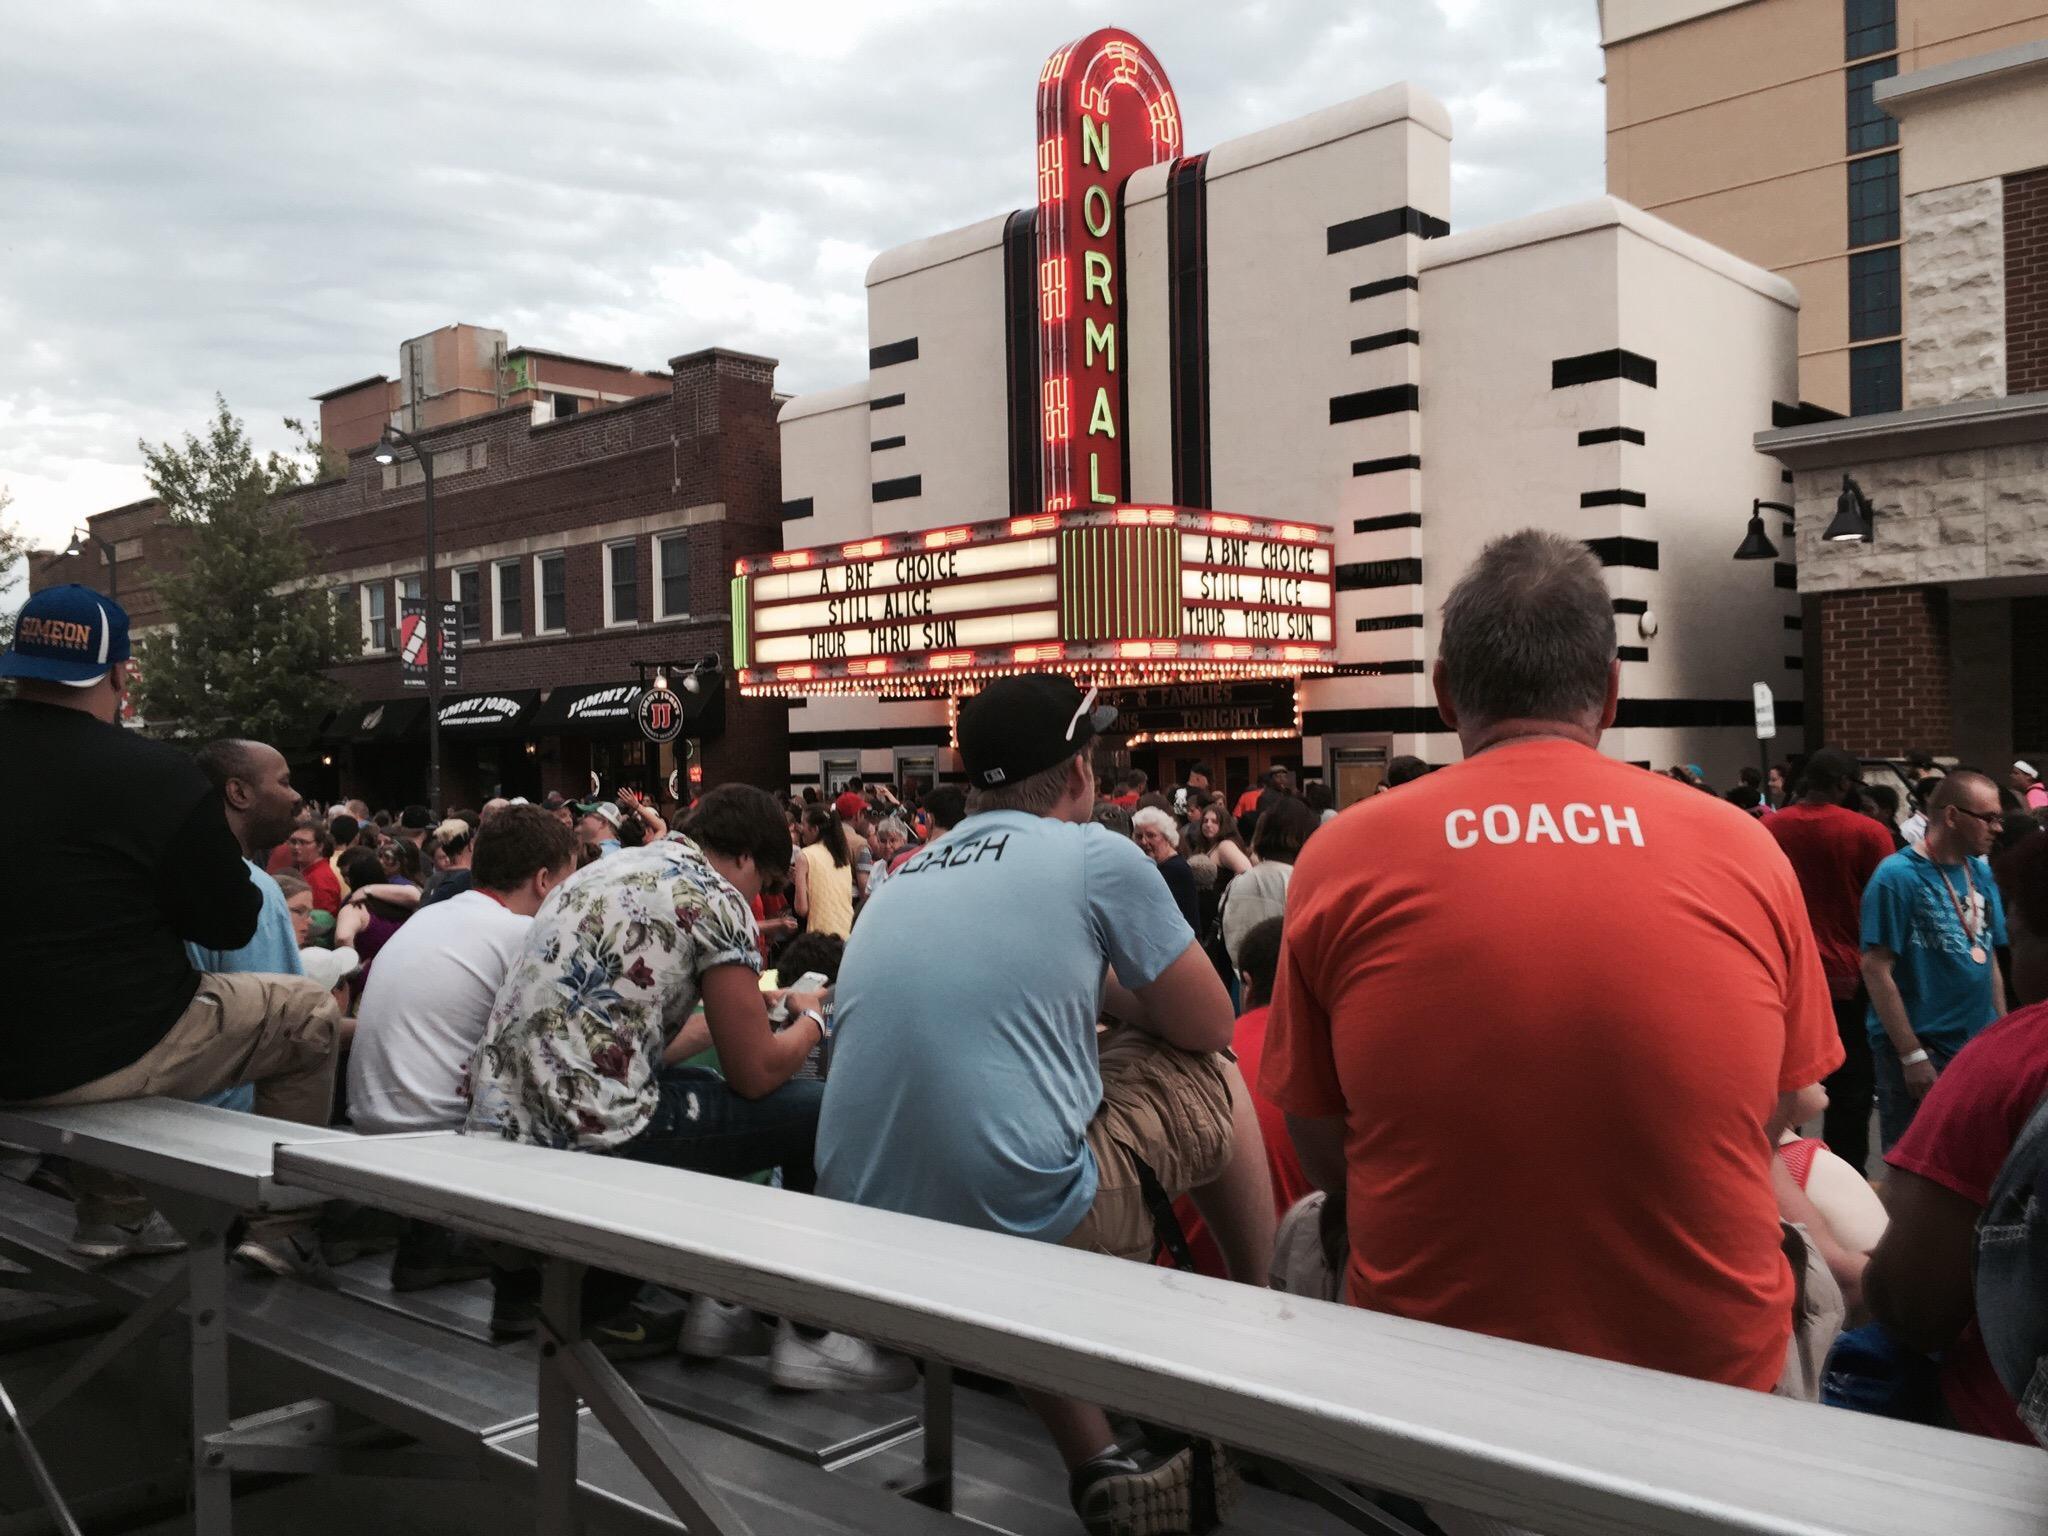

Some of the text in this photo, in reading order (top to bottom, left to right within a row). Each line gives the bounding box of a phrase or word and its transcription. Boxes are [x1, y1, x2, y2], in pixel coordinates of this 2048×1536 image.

[1082, 113, 1117, 505] NORMAL
[819, 551, 958, 594] A BNF CHOICE
[1205, 536, 1315, 574] A BNF CHOICE
[1200, 571, 1302, 606] STILL ALICE
[828, 590, 932, 626] STILL ALICE
[1186, 606, 1314, 641] THUR THRU SUN
[21, 617, 91, 643] SIMEON
[808, 620, 957, 660] THUR THRU SUN
[437, 698, 483, 720] IMMY
[567, 687, 628, 719] JIMMY
[1160, 685, 1232, 705] FAMILIES
[651, 703, 671, 730] JJ
[1444, 802, 1646, 850] COACH
[899, 833, 1010, 875] OACH
